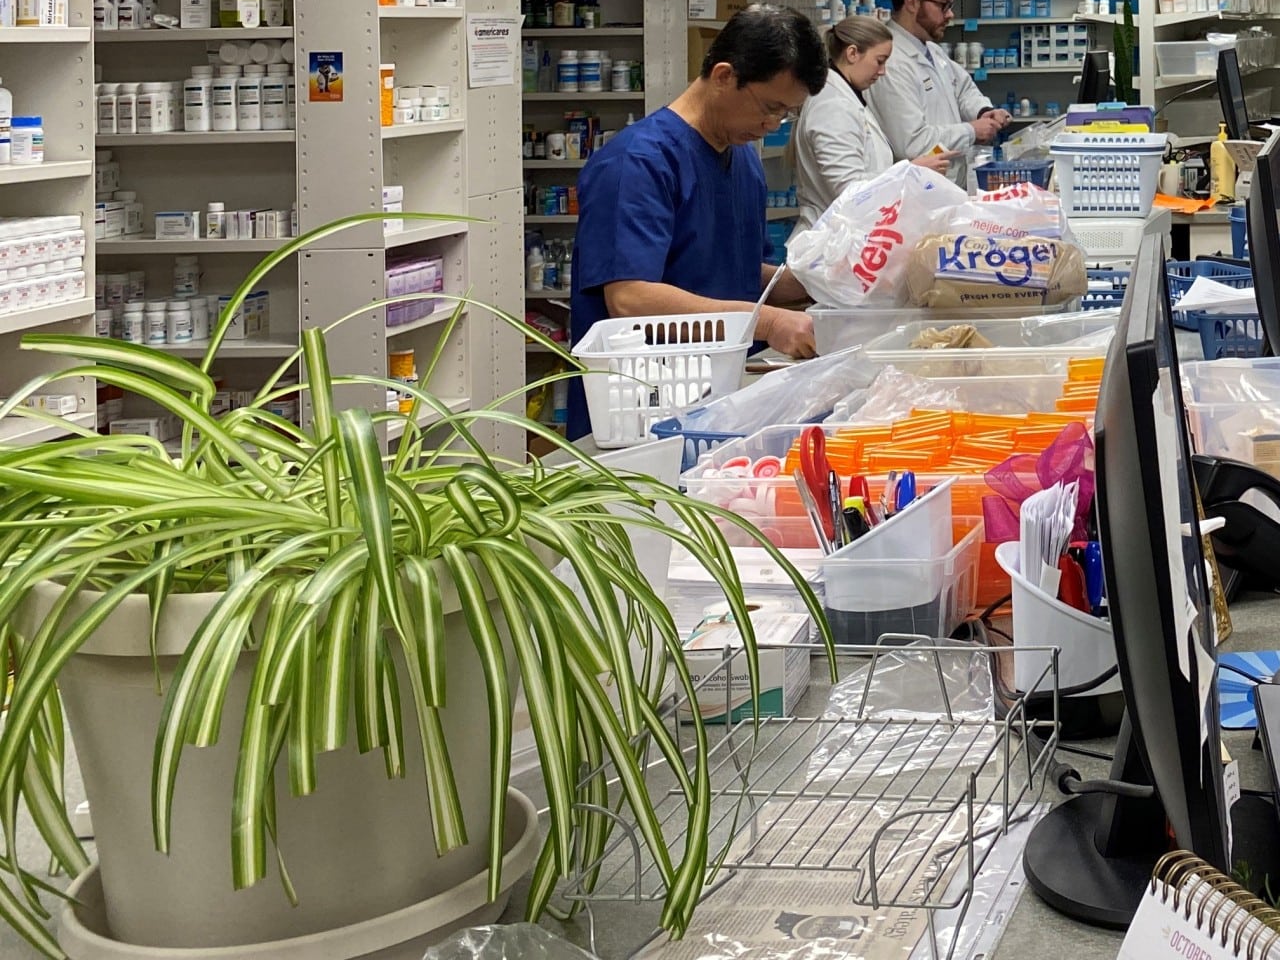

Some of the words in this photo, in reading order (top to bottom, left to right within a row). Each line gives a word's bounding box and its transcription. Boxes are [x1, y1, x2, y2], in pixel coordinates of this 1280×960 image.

[938, 235, 1058, 286] Kroger
[960, 291, 988, 304] FRESH
[992, 291, 1011, 300] FOR
